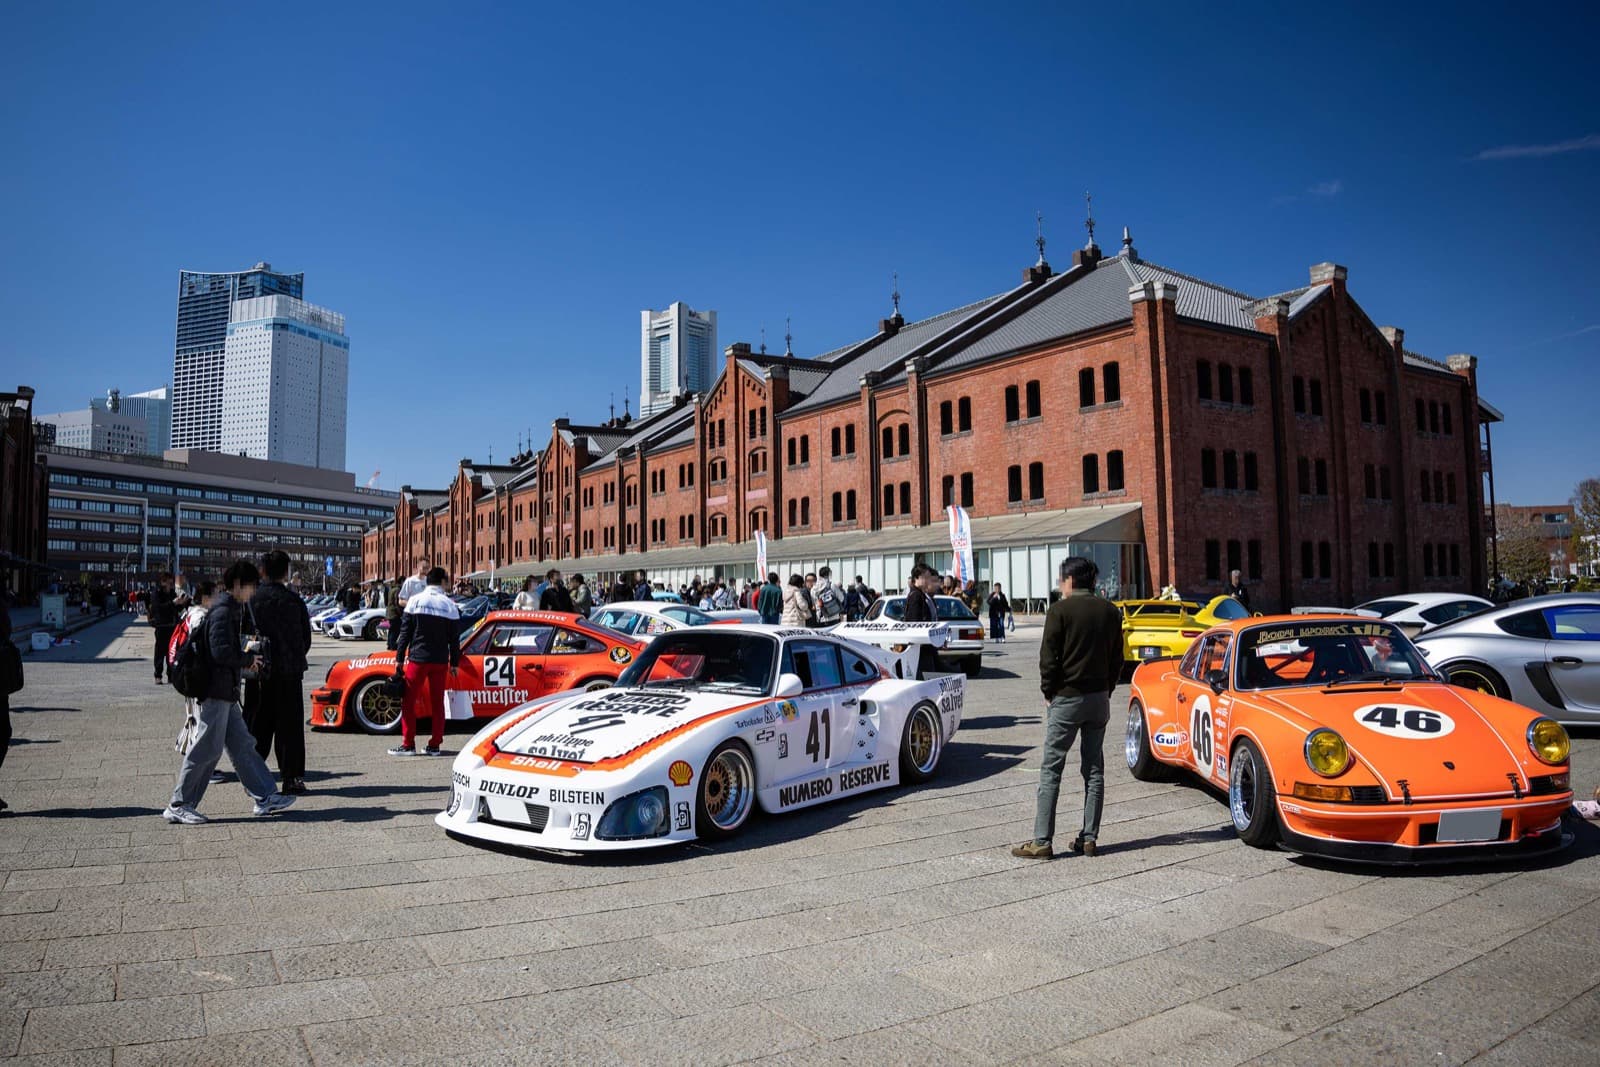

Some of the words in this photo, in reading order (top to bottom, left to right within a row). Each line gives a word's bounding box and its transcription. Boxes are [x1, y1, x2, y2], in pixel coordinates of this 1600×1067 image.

[485, 657, 515, 686] 24
[470, 688, 528, 706] rmeister
[1362, 707, 1442, 733] 46
[533, 733, 594, 748] philippe
[806, 709, 831, 763] 41
[1193, 709, 1212, 766] 46
[510, 756, 562, 771] Shell
[479, 779, 540, 799] DUNLOP
[550, 789, 605, 805] BILSTEIN
[779, 777, 833, 808] NUMERO
